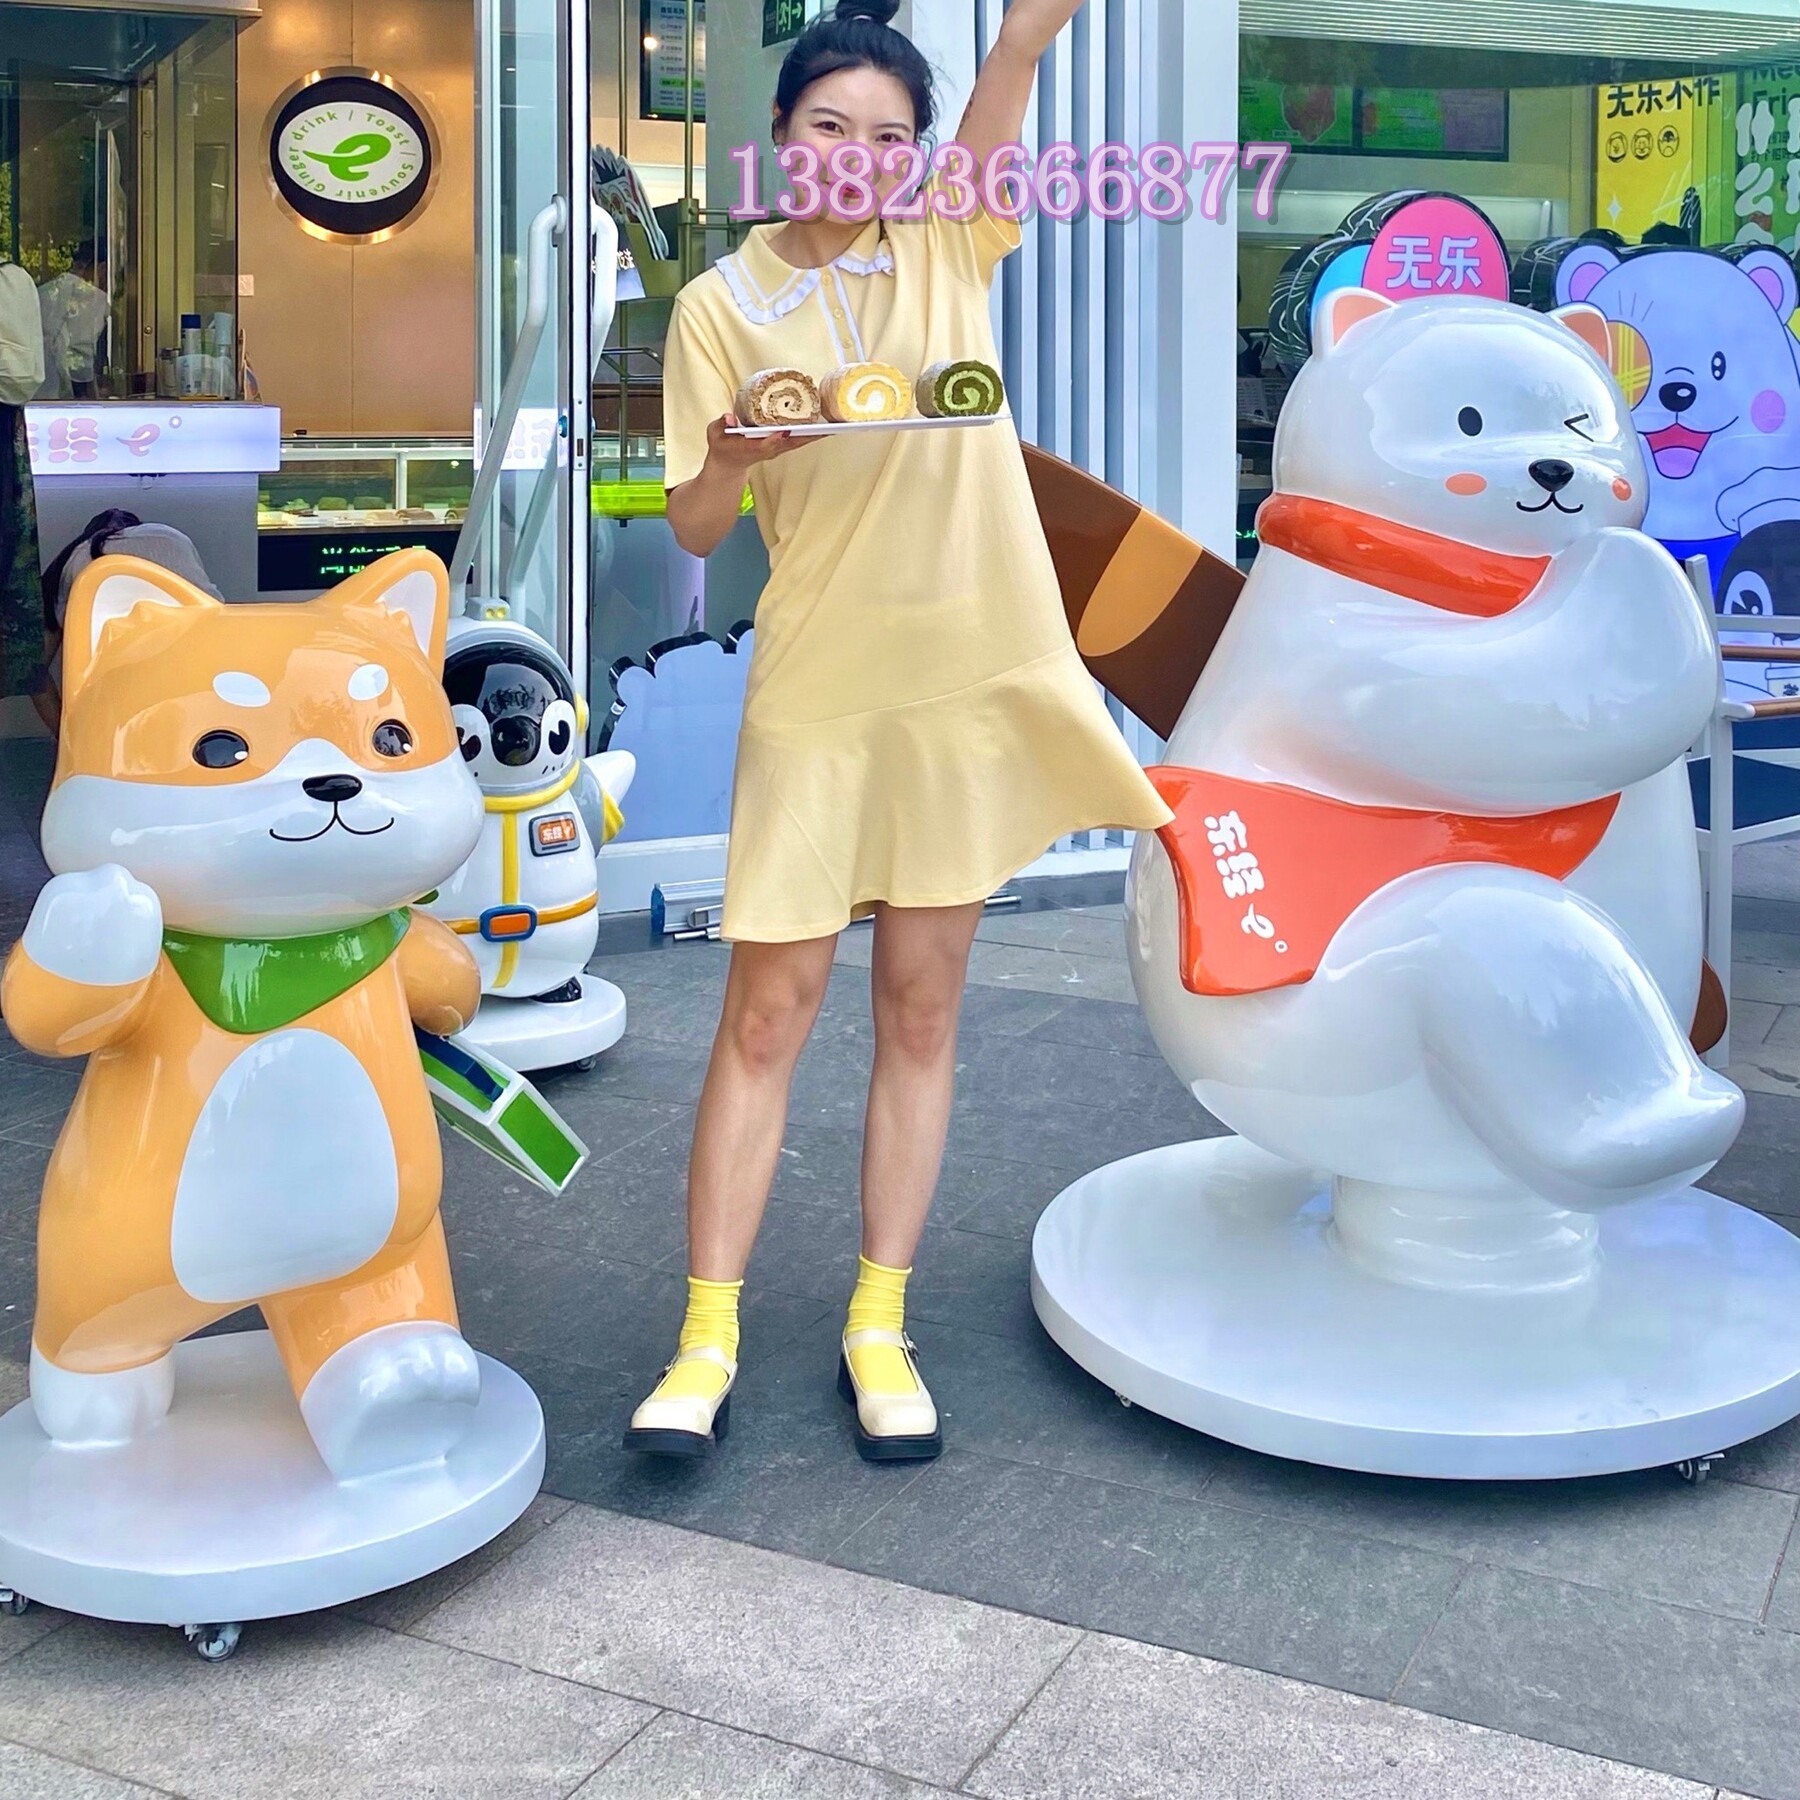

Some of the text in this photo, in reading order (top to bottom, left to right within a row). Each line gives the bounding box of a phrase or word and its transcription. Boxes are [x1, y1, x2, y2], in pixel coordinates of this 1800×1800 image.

[292, 111, 338, 141] drink
[365, 112, 411, 146] Toast
[289, 147, 326, 193] Ginger
[335, 163, 414, 200] Souvenir
[1386, 235, 1483, 290] 无乐
